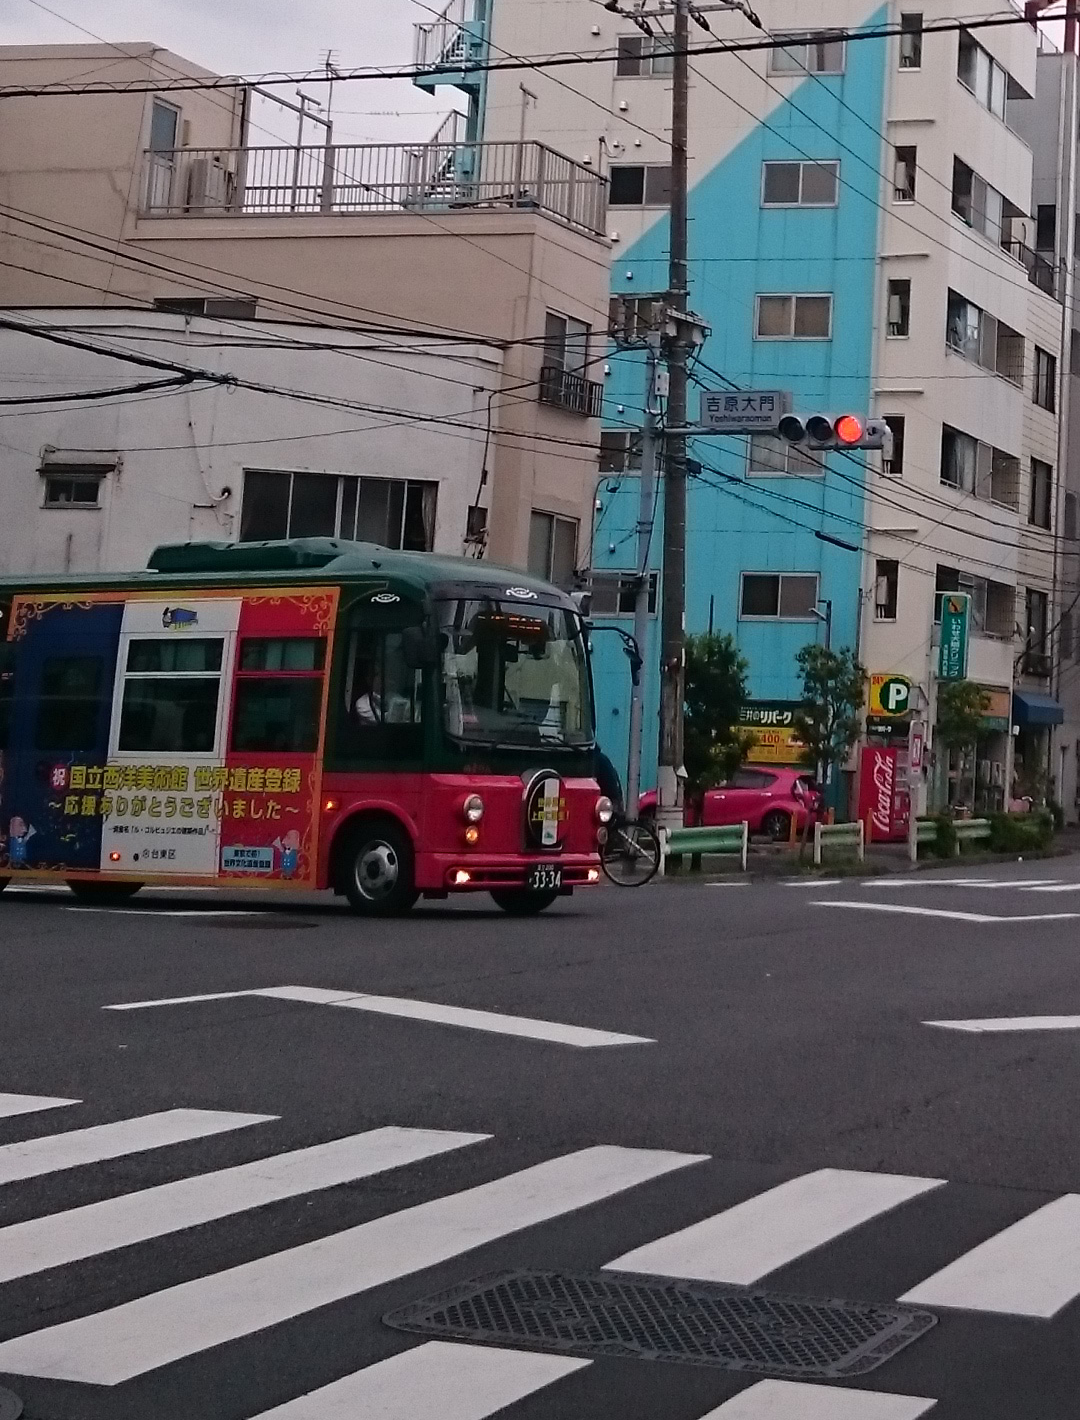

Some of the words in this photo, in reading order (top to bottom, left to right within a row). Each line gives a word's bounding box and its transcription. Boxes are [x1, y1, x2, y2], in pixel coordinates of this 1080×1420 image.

[706, 395, 775, 412] 吉原大門
[888, 683, 908, 709] P
[740, 710, 792, 724] 三井のリパーク
[52, 767, 66, 787] 祝
[69, 765, 189, 792] 国立西洋美術館
[193, 766, 301, 793] 世界遺産登録
[150, 848, 177, 860] 台東区
